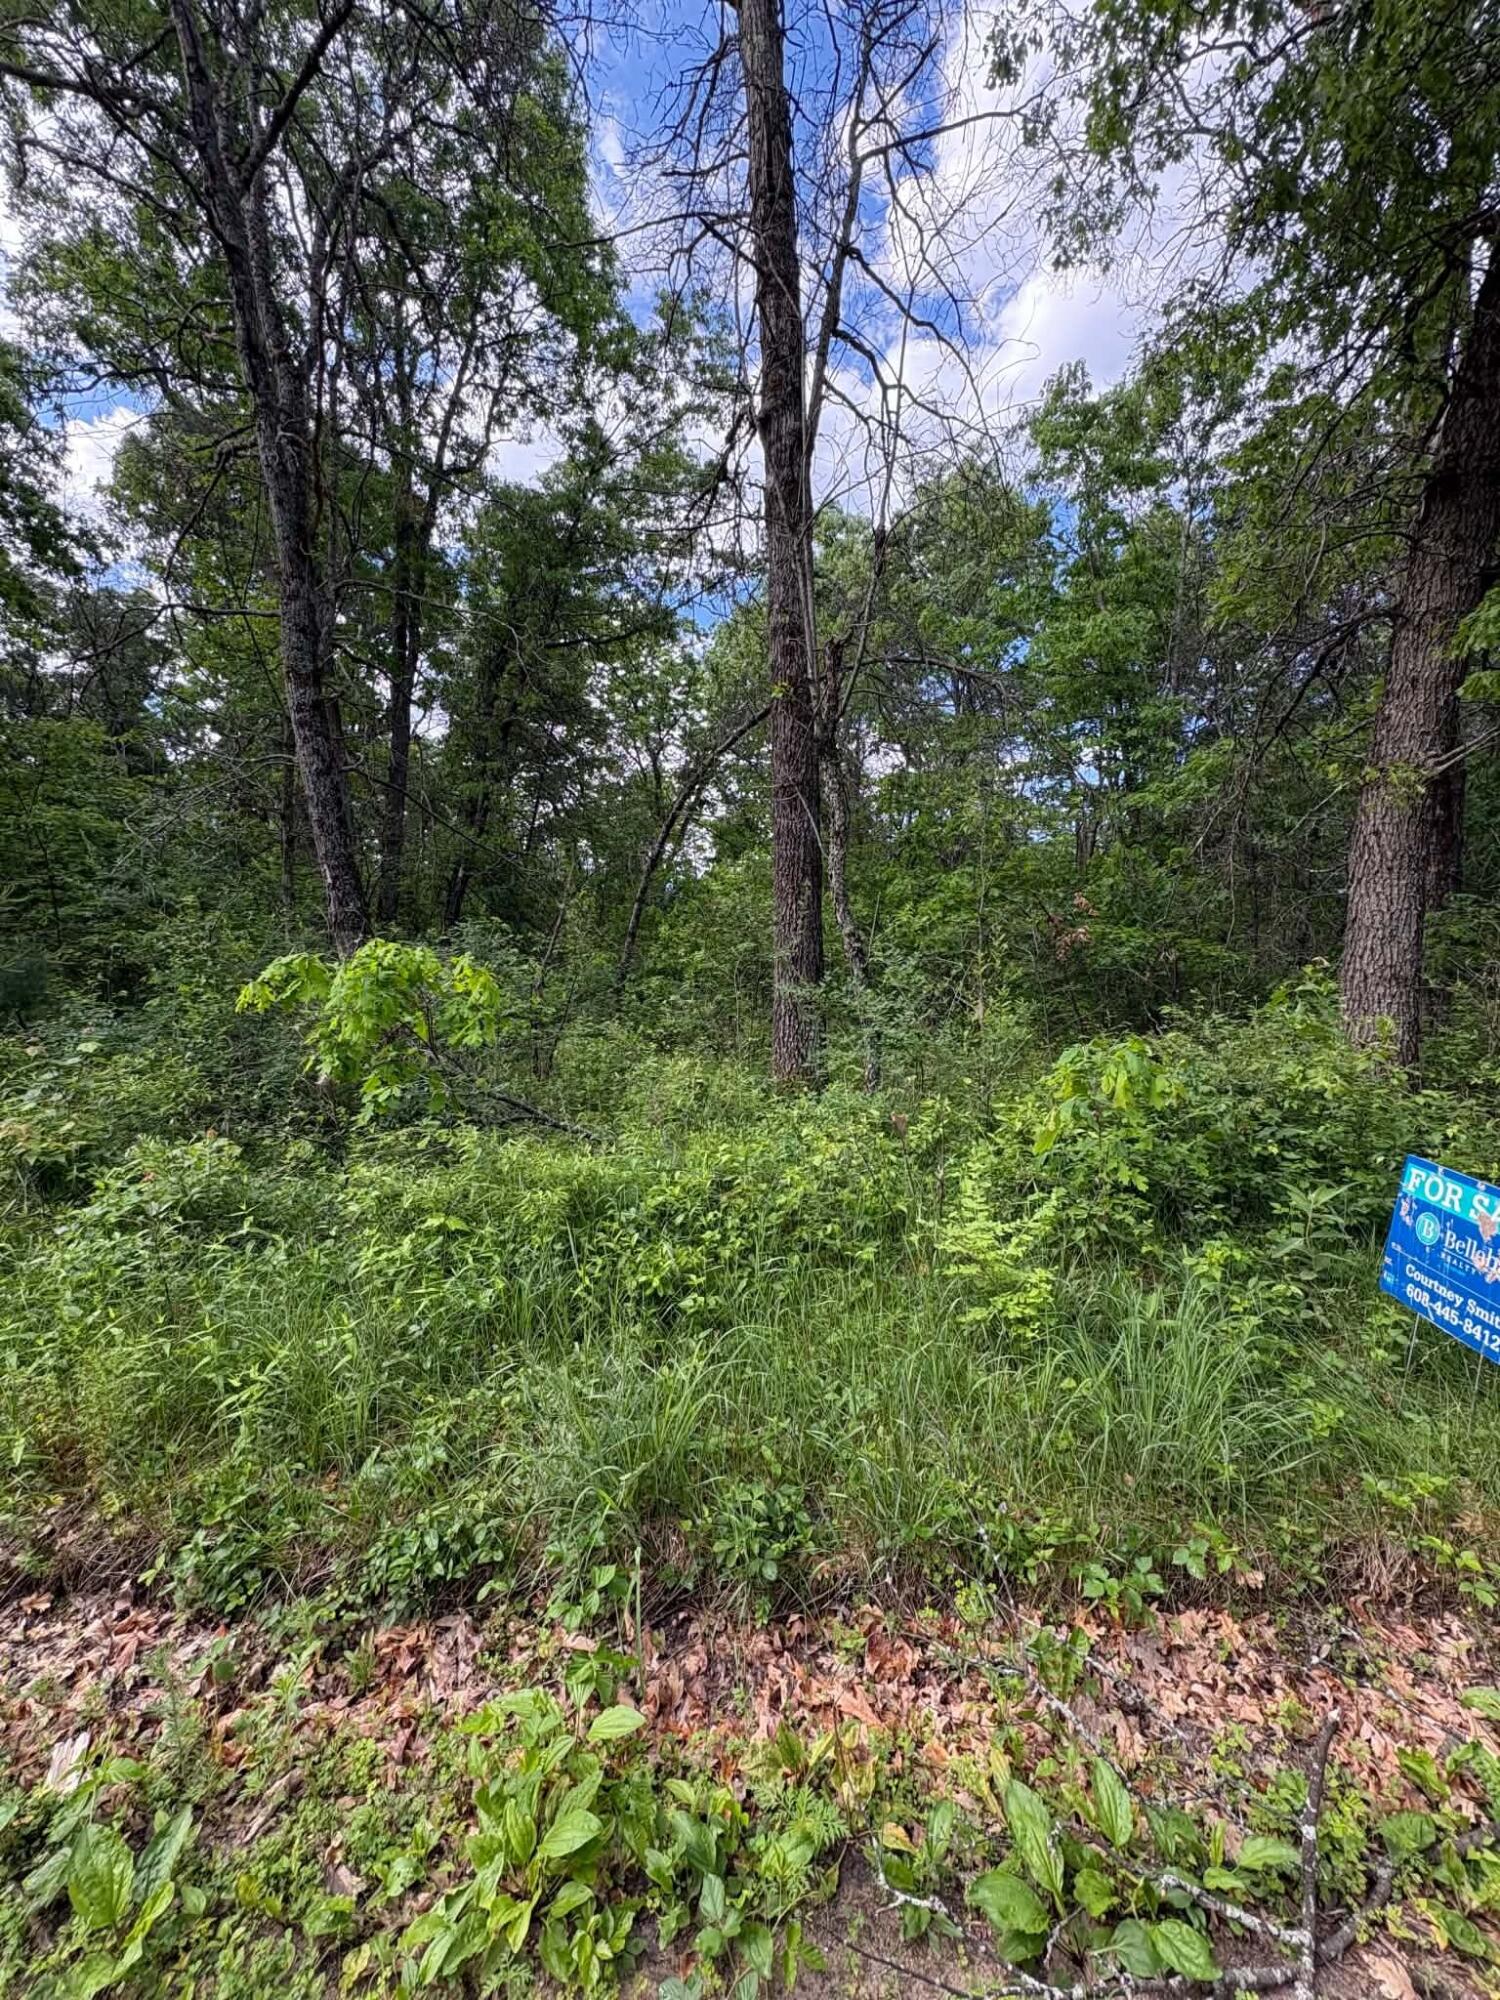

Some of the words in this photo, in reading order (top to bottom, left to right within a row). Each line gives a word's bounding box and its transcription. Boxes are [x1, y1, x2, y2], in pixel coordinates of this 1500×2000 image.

[1407, 1167, 1463, 1213] FOR
[1405, 1263, 1464, 1307] Courtney
[1406, 1283, 1500, 1353] 608-445-8412
